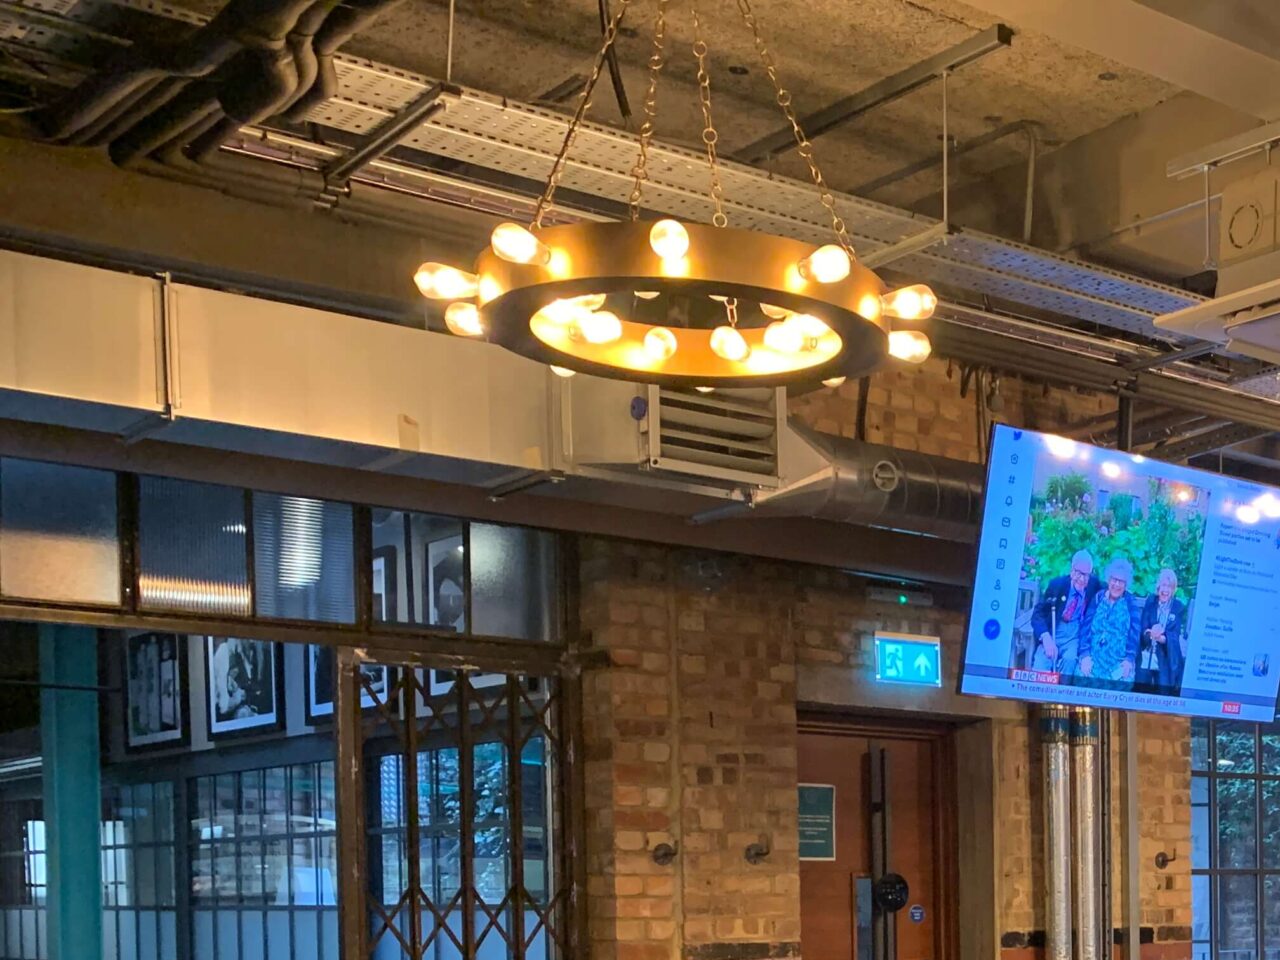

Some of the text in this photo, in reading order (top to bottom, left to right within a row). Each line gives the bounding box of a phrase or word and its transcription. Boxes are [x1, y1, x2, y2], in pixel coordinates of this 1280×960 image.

[1013, 670, 1058, 684] BBC NEWS
[1017, 683, 1028, 691] The
[1029, 685, 1057, 694] comedian
[1076, 689, 1087, 697] and
